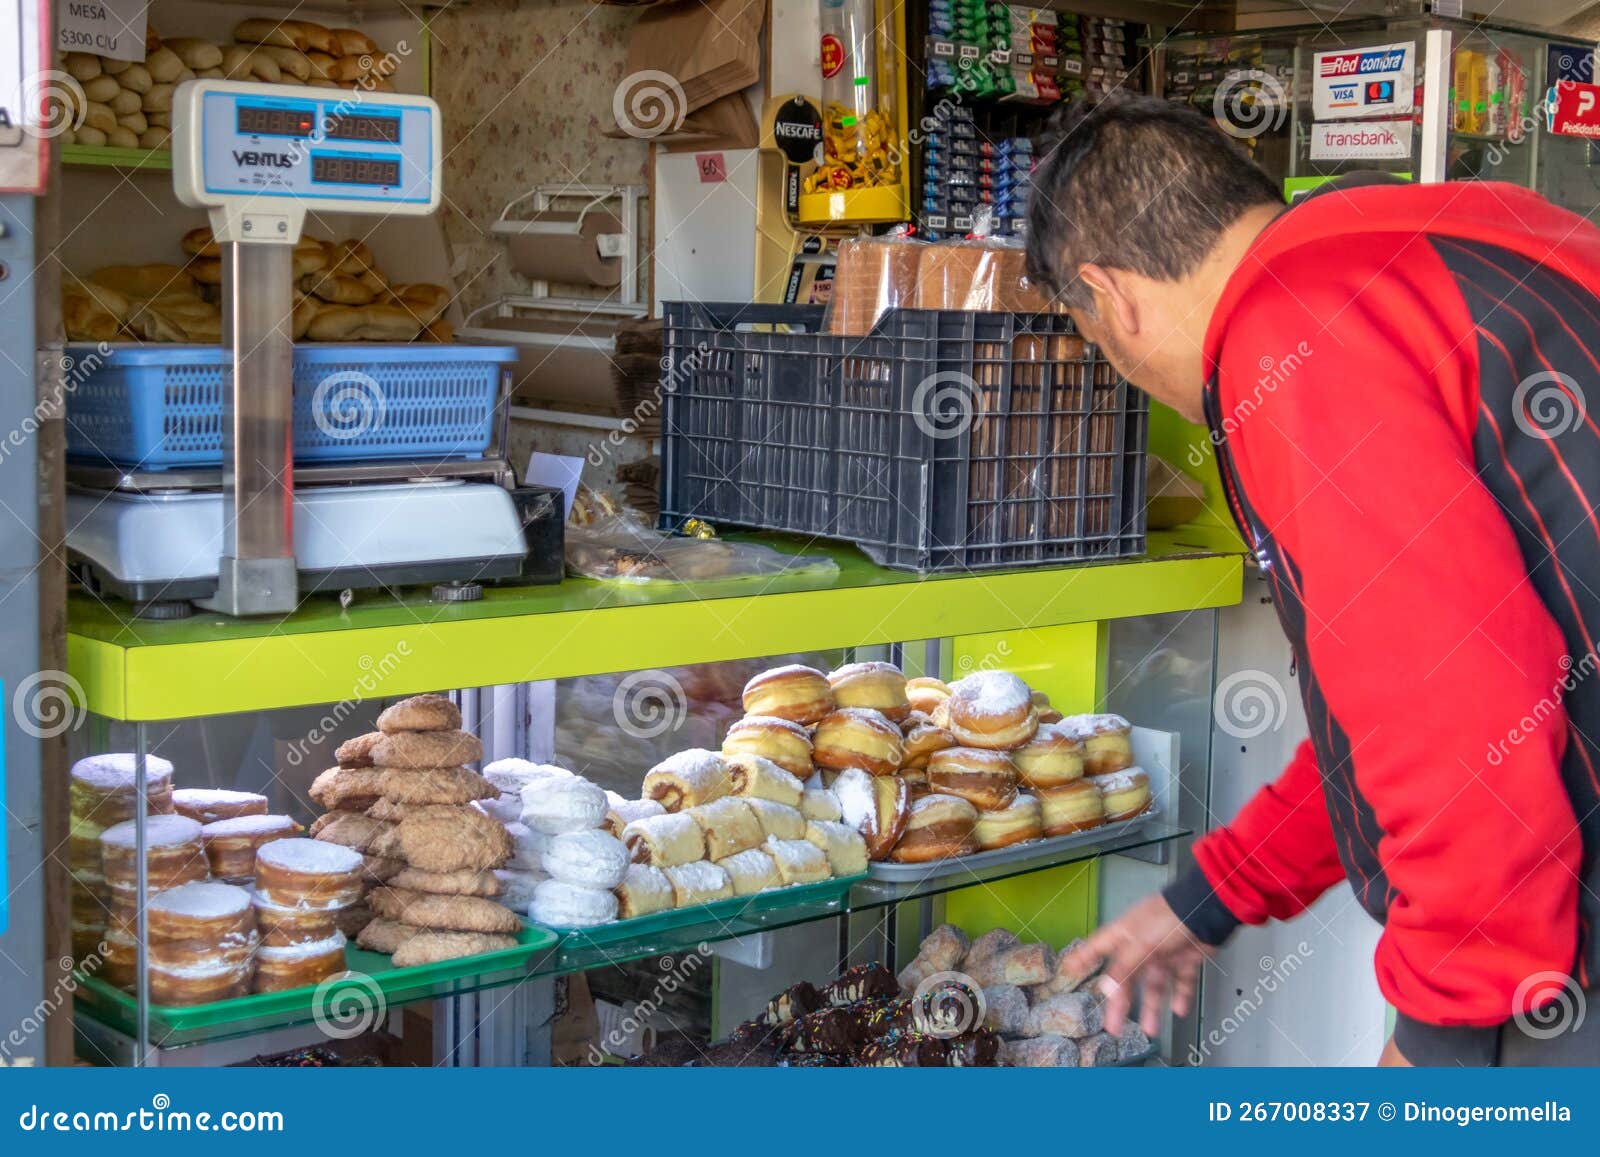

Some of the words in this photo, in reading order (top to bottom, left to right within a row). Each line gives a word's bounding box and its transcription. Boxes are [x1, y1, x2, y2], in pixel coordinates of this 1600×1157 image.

[69, 3, 106, 20] MESA
[61, 28, 92, 46] $300
[96, 34, 117, 51] C/U
[1333, 56, 1359, 73] Red
[1360, 53, 1402, 72] compra
[1333, 90, 1354, 100] VISA
[776, 121, 820, 139] NESCAFÉ
[232, 150, 292, 168] VENTUS
